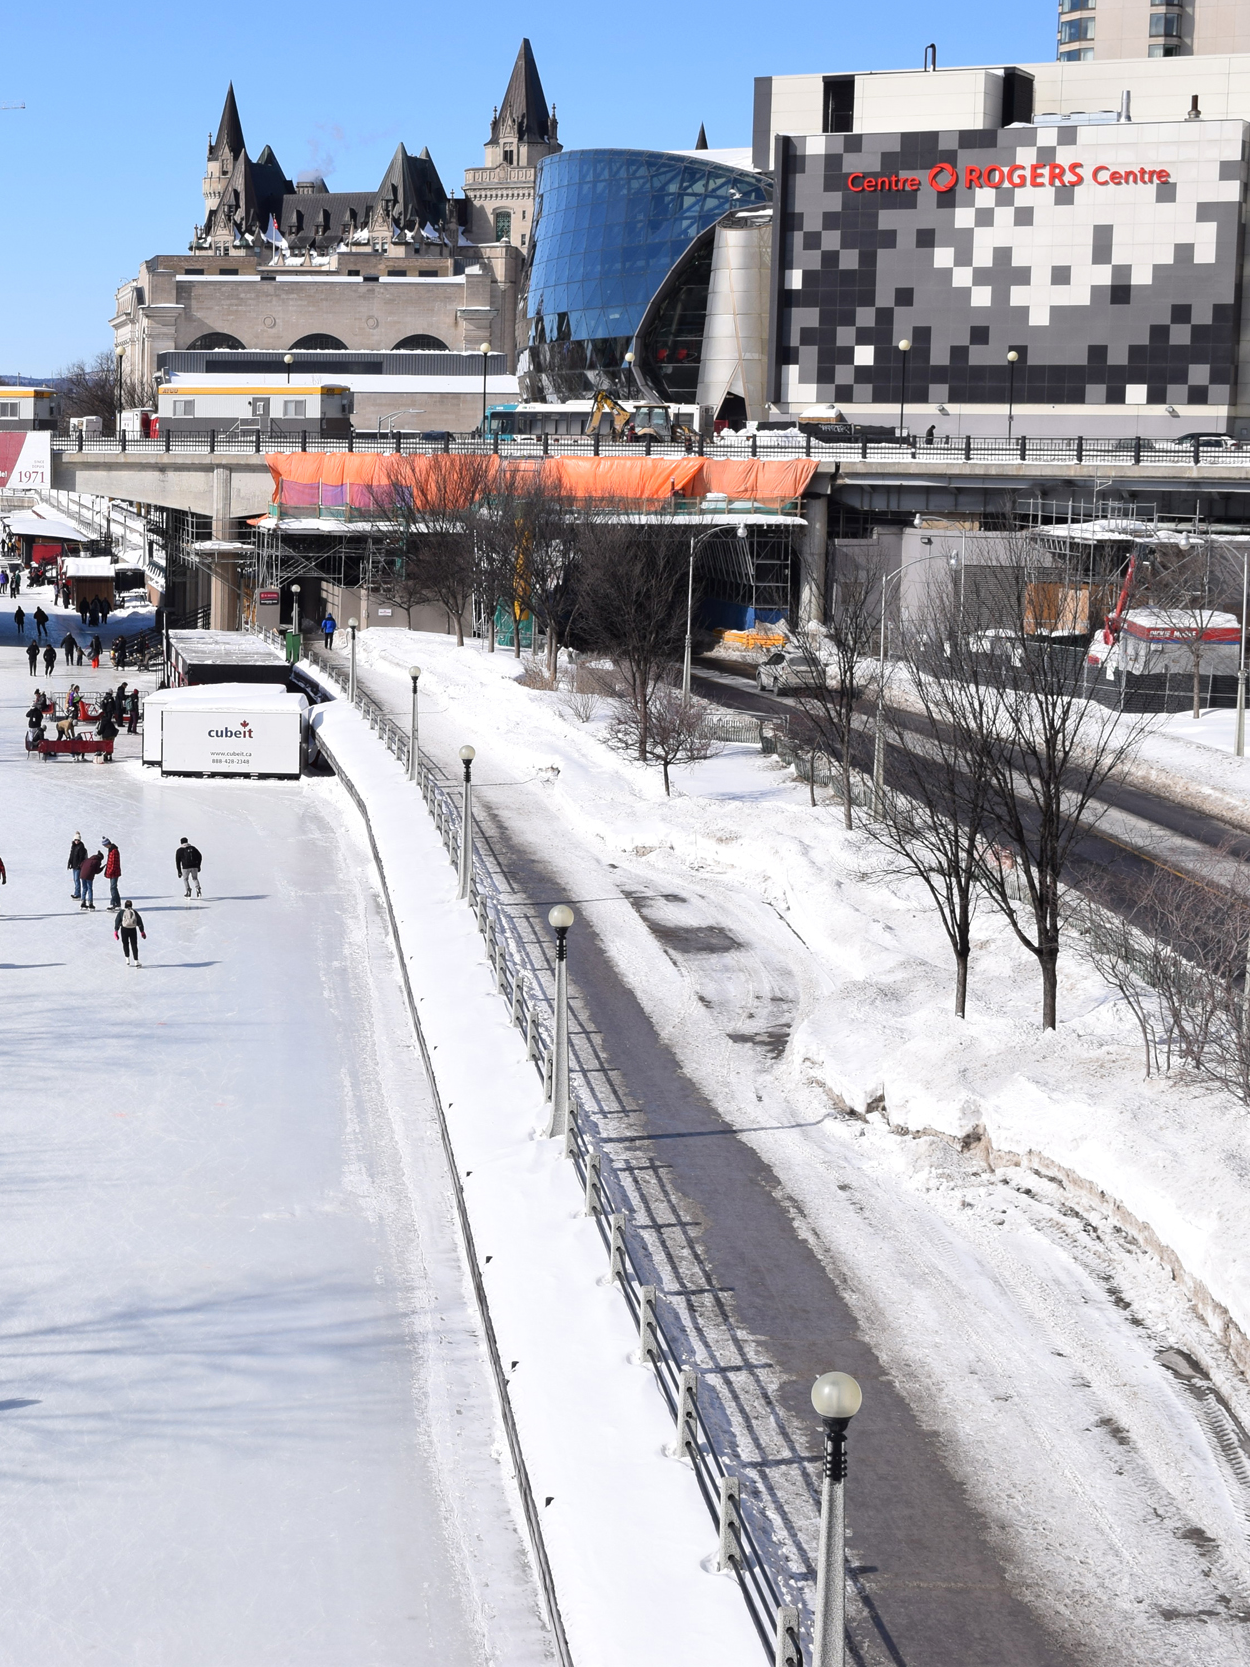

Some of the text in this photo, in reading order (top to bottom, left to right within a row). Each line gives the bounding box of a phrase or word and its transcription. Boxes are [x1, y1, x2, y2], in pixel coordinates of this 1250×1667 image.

[848, 162, 1170, 192] Centre ROGERS Centre
[18, 470, 45, 483] 1971
[208, 725, 254, 739] cubeit
